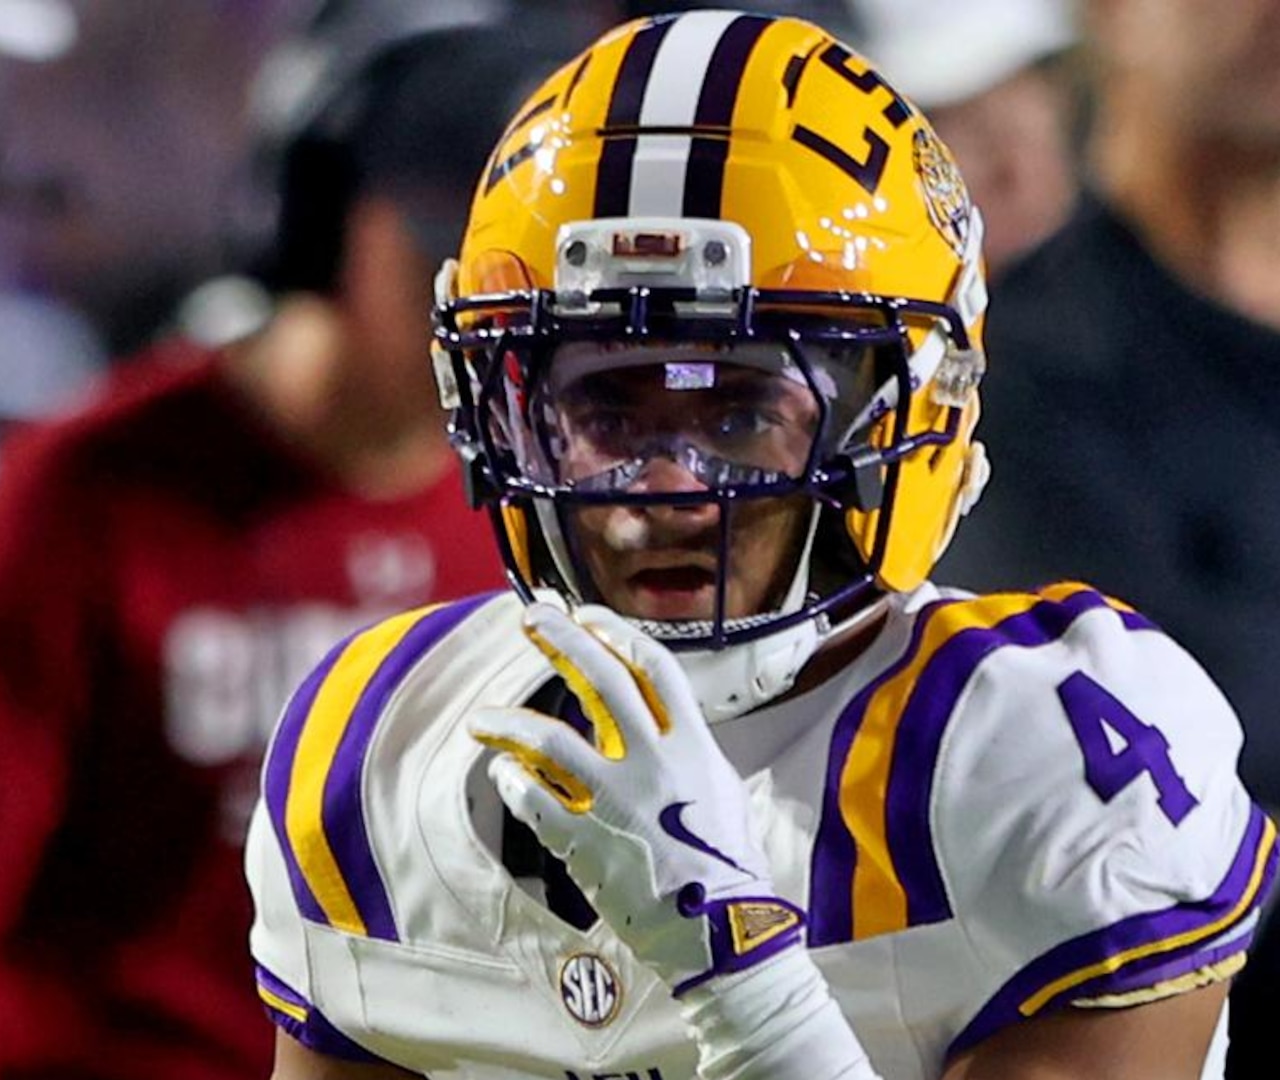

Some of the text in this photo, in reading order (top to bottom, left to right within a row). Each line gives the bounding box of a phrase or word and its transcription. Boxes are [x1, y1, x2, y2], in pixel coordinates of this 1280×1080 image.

[790, 42, 913, 197] LS
[1056, 668, 1200, 828] 4
[562, 955, 616, 1022] SEC
